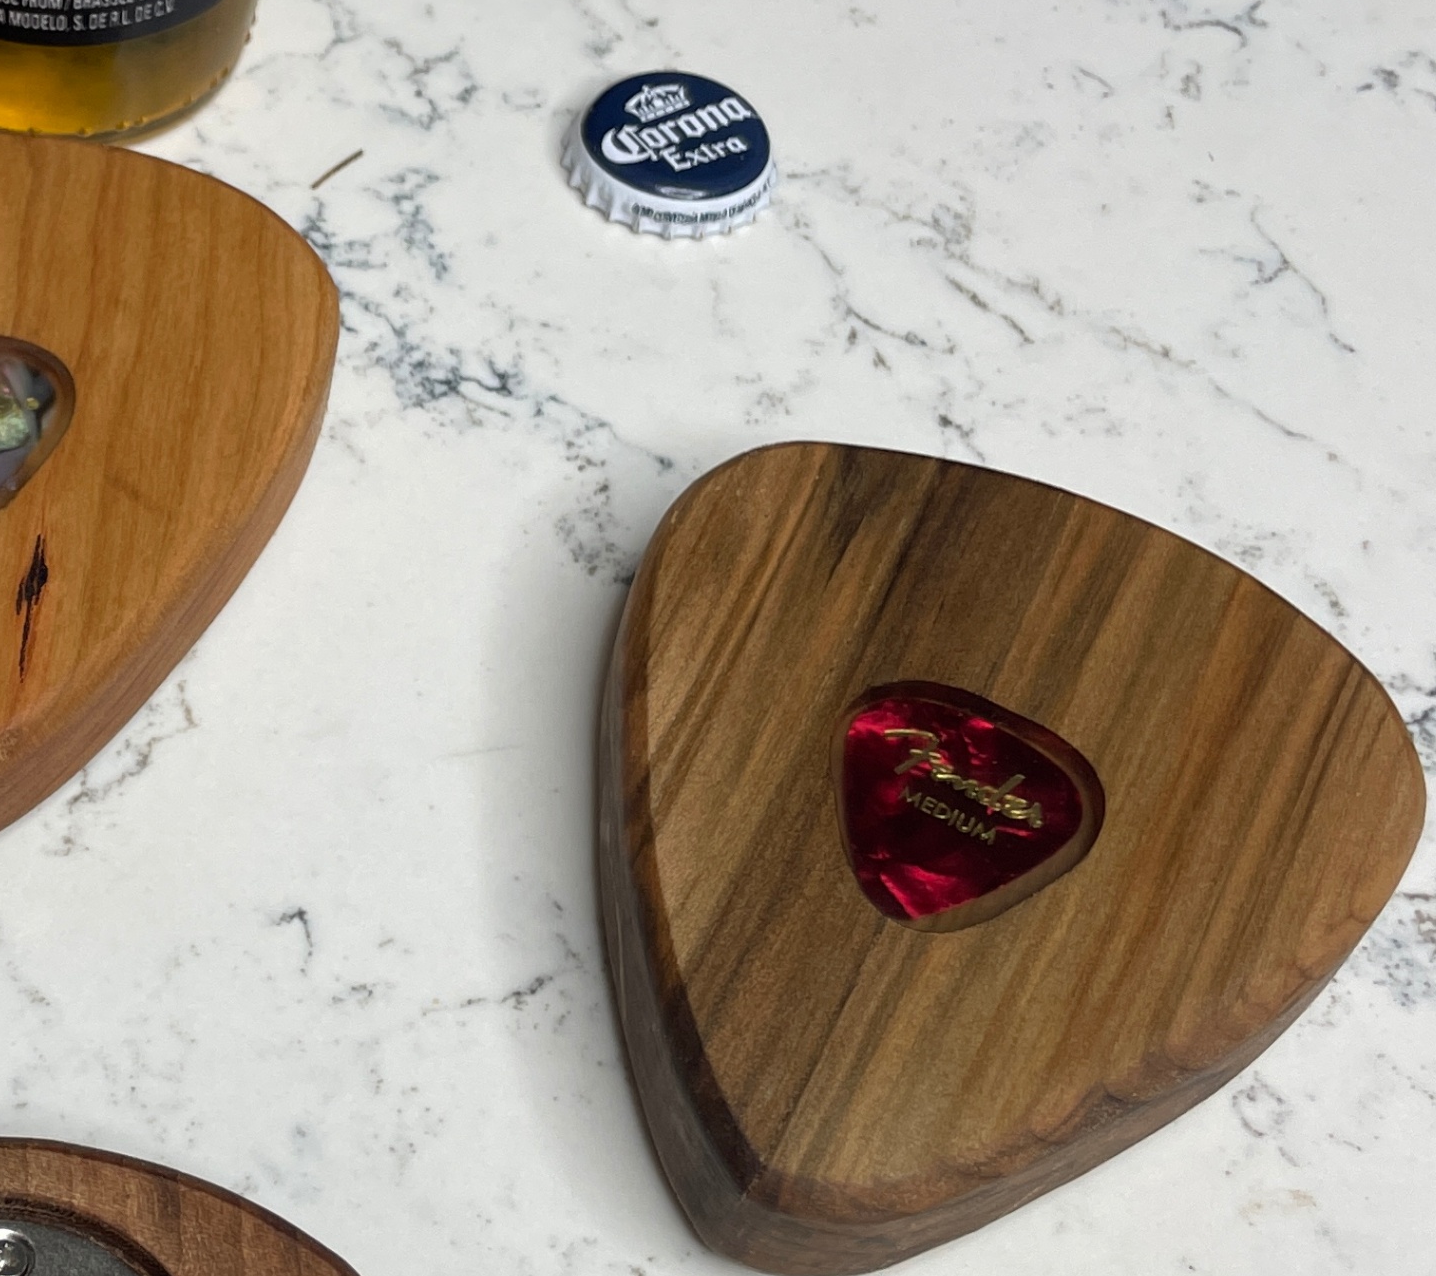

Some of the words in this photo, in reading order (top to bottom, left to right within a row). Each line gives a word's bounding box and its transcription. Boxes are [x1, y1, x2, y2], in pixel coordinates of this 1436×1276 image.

[601, 97, 751, 165] Corona
[660, 136, 748, 172] Extra
[884, 728, 1044, 829] Fender
[899, 786, 997, 846] MEDIUM
